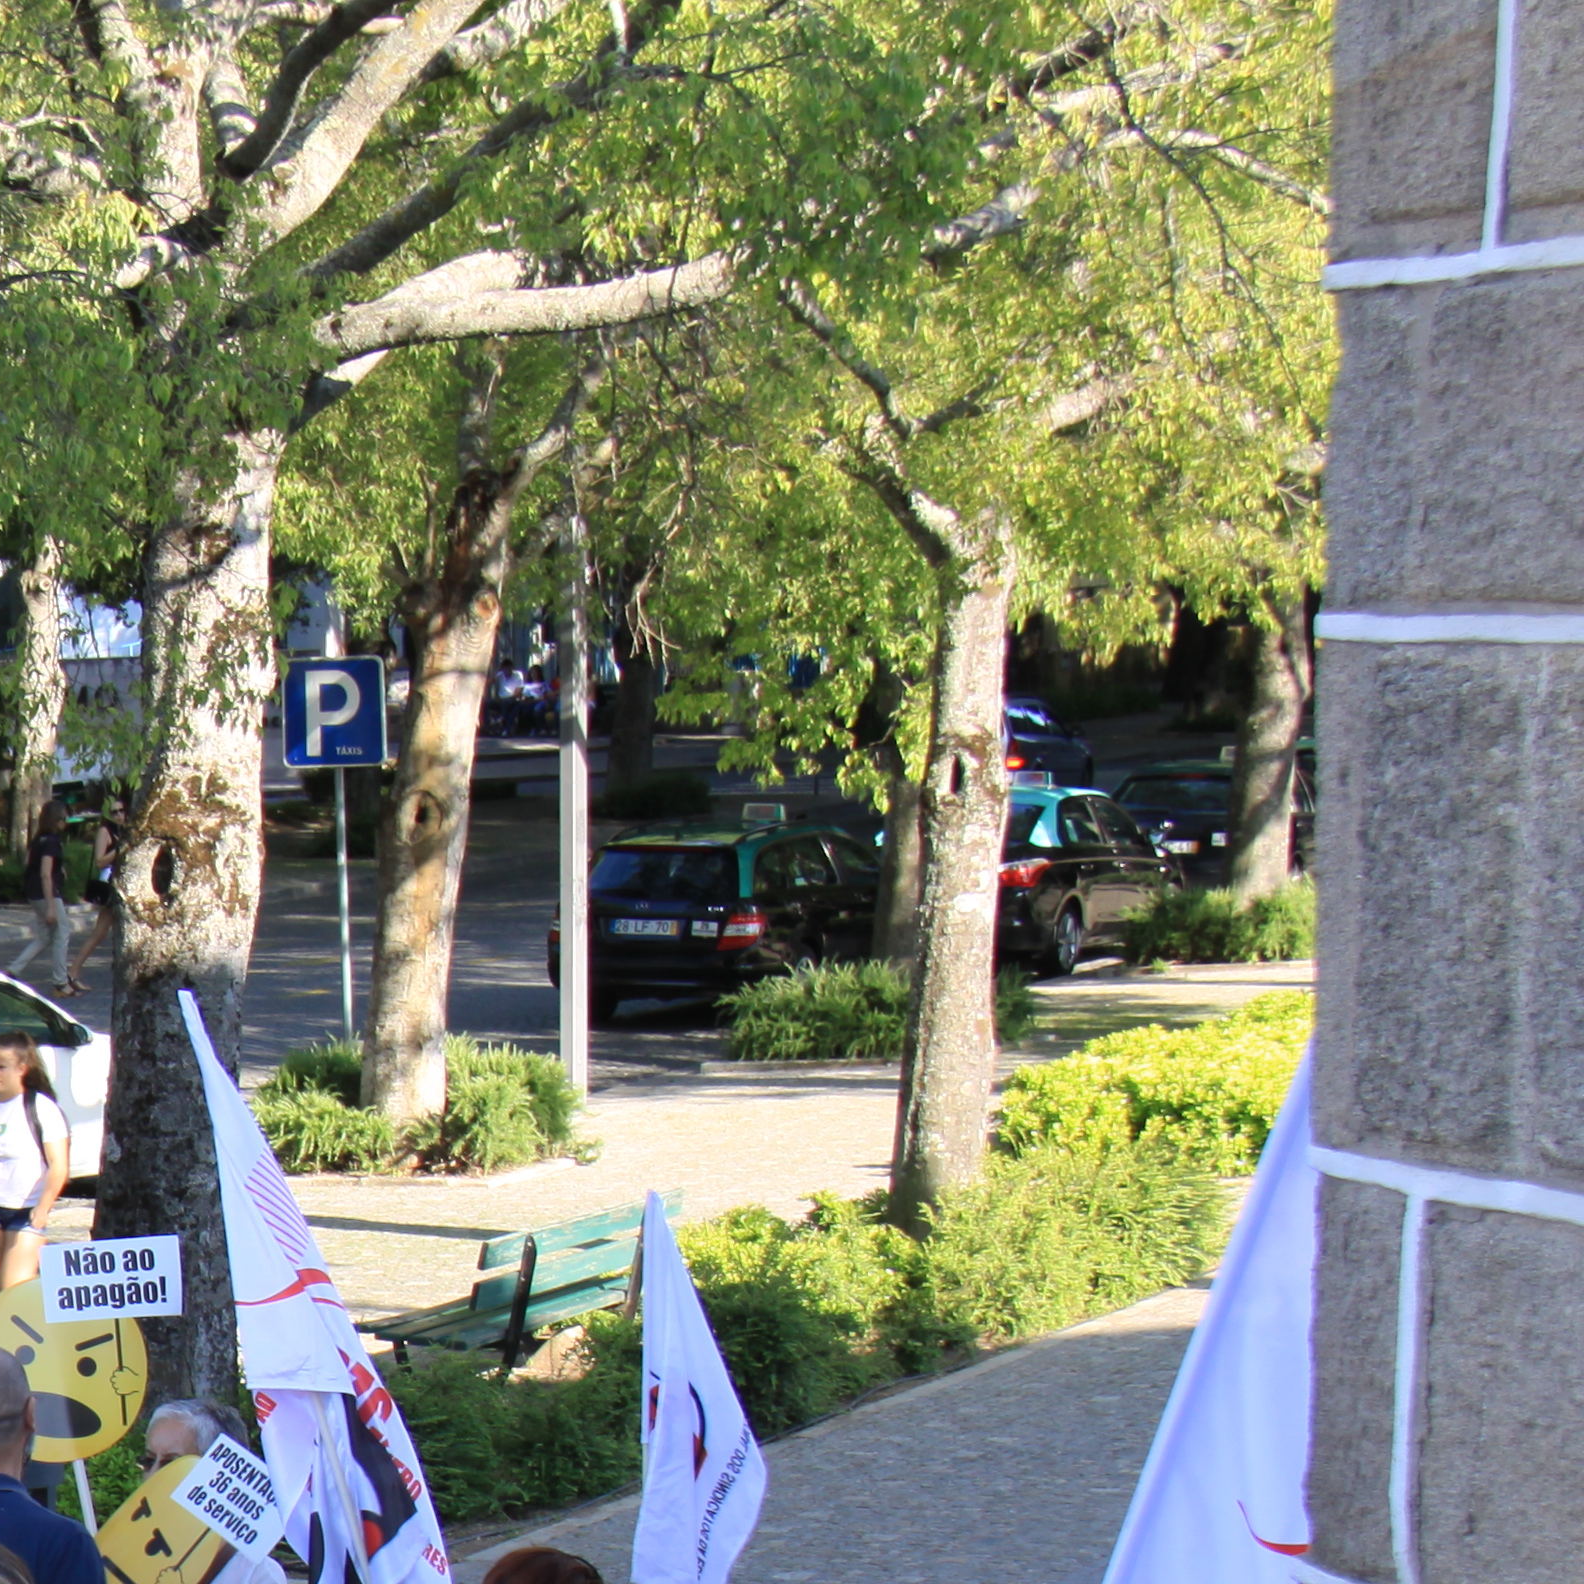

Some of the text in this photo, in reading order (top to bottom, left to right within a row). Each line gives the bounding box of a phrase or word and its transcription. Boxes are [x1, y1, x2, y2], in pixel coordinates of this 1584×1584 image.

[305, 669, 361, 757] P
[63, 1246, 155, 1277] Não ao
[57, 1275, 168, 1311] apagão!
[186, 1484, 258, 1545] de serviço
[208, 1470, 265, 1521] 36 anos
